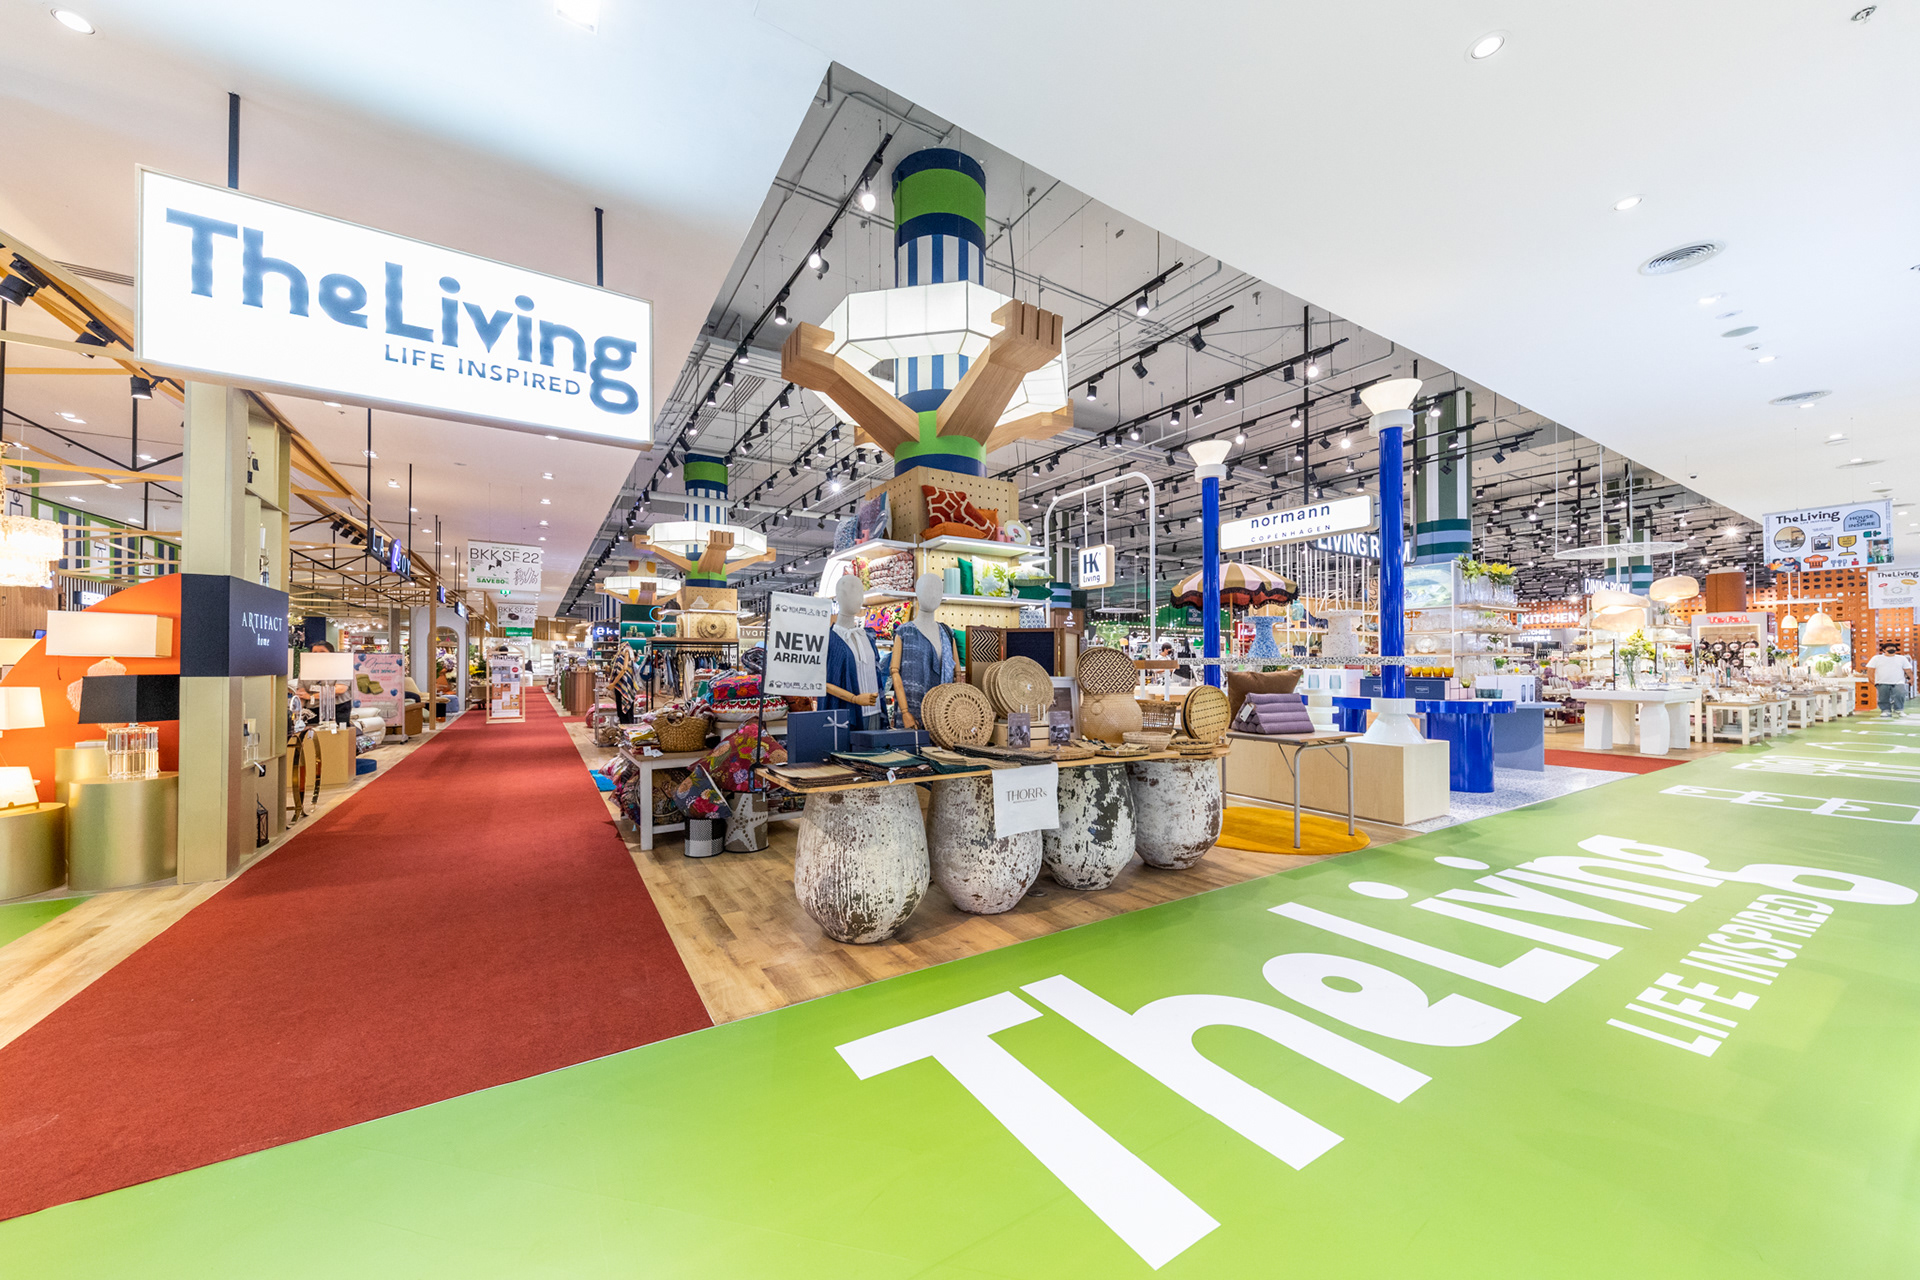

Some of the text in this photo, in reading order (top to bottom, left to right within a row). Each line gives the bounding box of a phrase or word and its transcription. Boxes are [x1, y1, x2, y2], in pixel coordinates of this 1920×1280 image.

[385, 344, 581, 396] LIFE INSPIRED
[1251, 505, 1330, 529] normann
[1250, 525, 1331, 543] COPENHAGEN
[1317, 532, 1367, 556] LIVING
[470, 548, 500, 560] BKK
[502, 550, 520, 562] SF
[522, 552, 540, 564] 22
[1083, 552, 1099, 574] HK
[241, 612, 283, 634] ARTIFACT
[1521, 612, 1579, 625] KITCHEN
[774, 631, 825, 653] NEW
[773, 651, 821, 665] ARRIVAL
[1606, 894, 1834, 1058] LIFE INSPIRED
